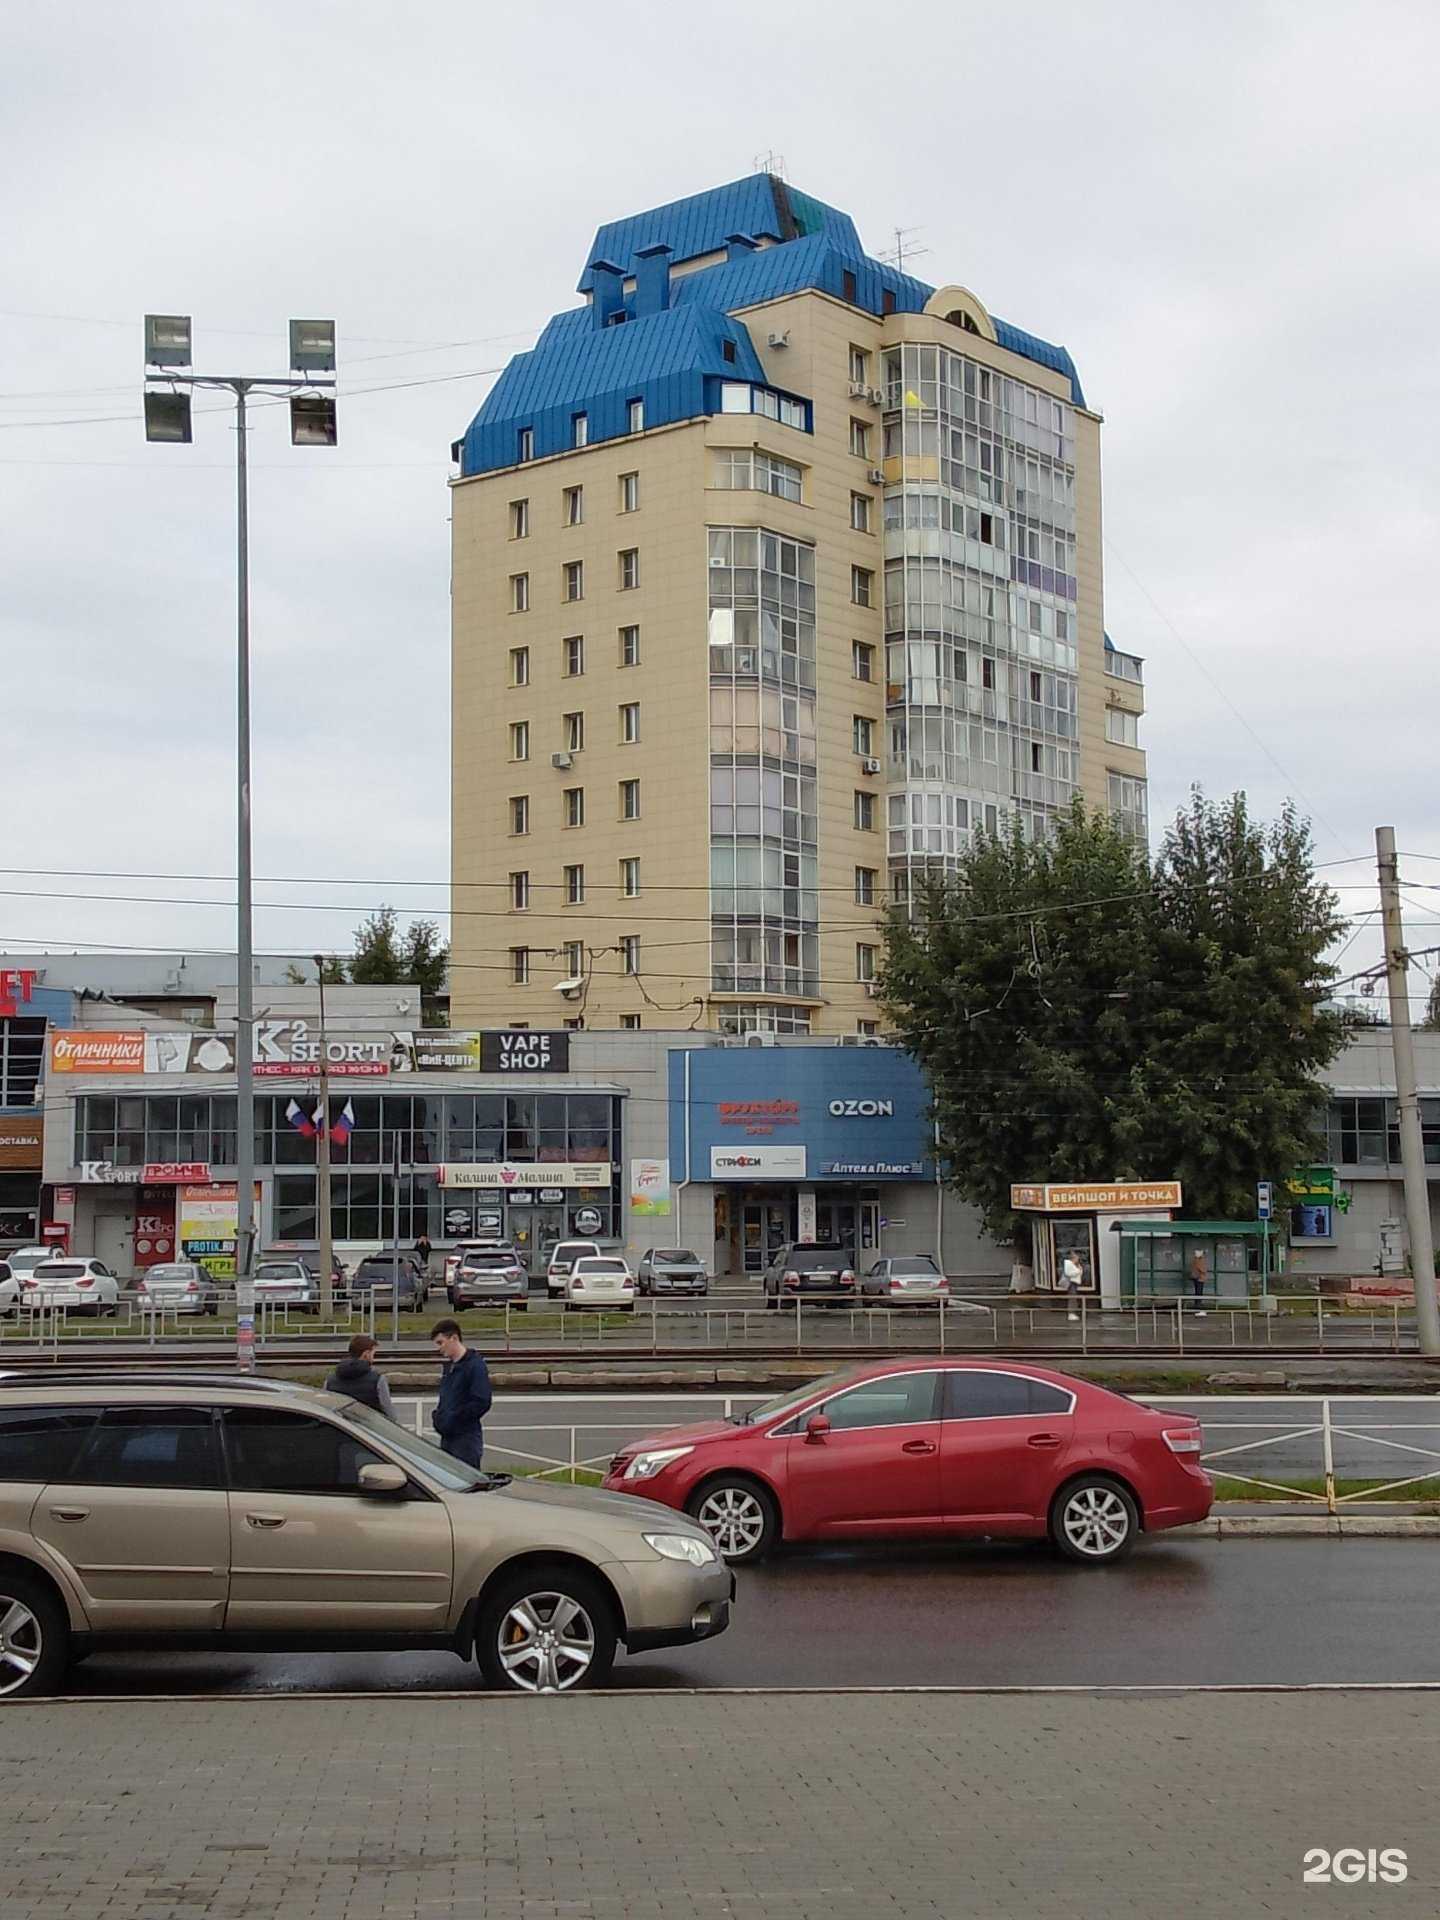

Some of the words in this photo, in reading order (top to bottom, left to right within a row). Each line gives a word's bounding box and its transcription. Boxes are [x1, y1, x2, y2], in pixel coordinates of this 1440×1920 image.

[500, 1035, 550, 1050] VAPE
[500, 1053, 550, 1069] SHOP
[830, 1100, 893, 1116] OZON
[454, 1173, 498, 1184] Калина
[519, 1173, 563, 1184] Малина
[1052, 1190, 1117, 1204] ВЕЙПШОП
[1131, 1189, 1174, 1201] ТОЧКА
